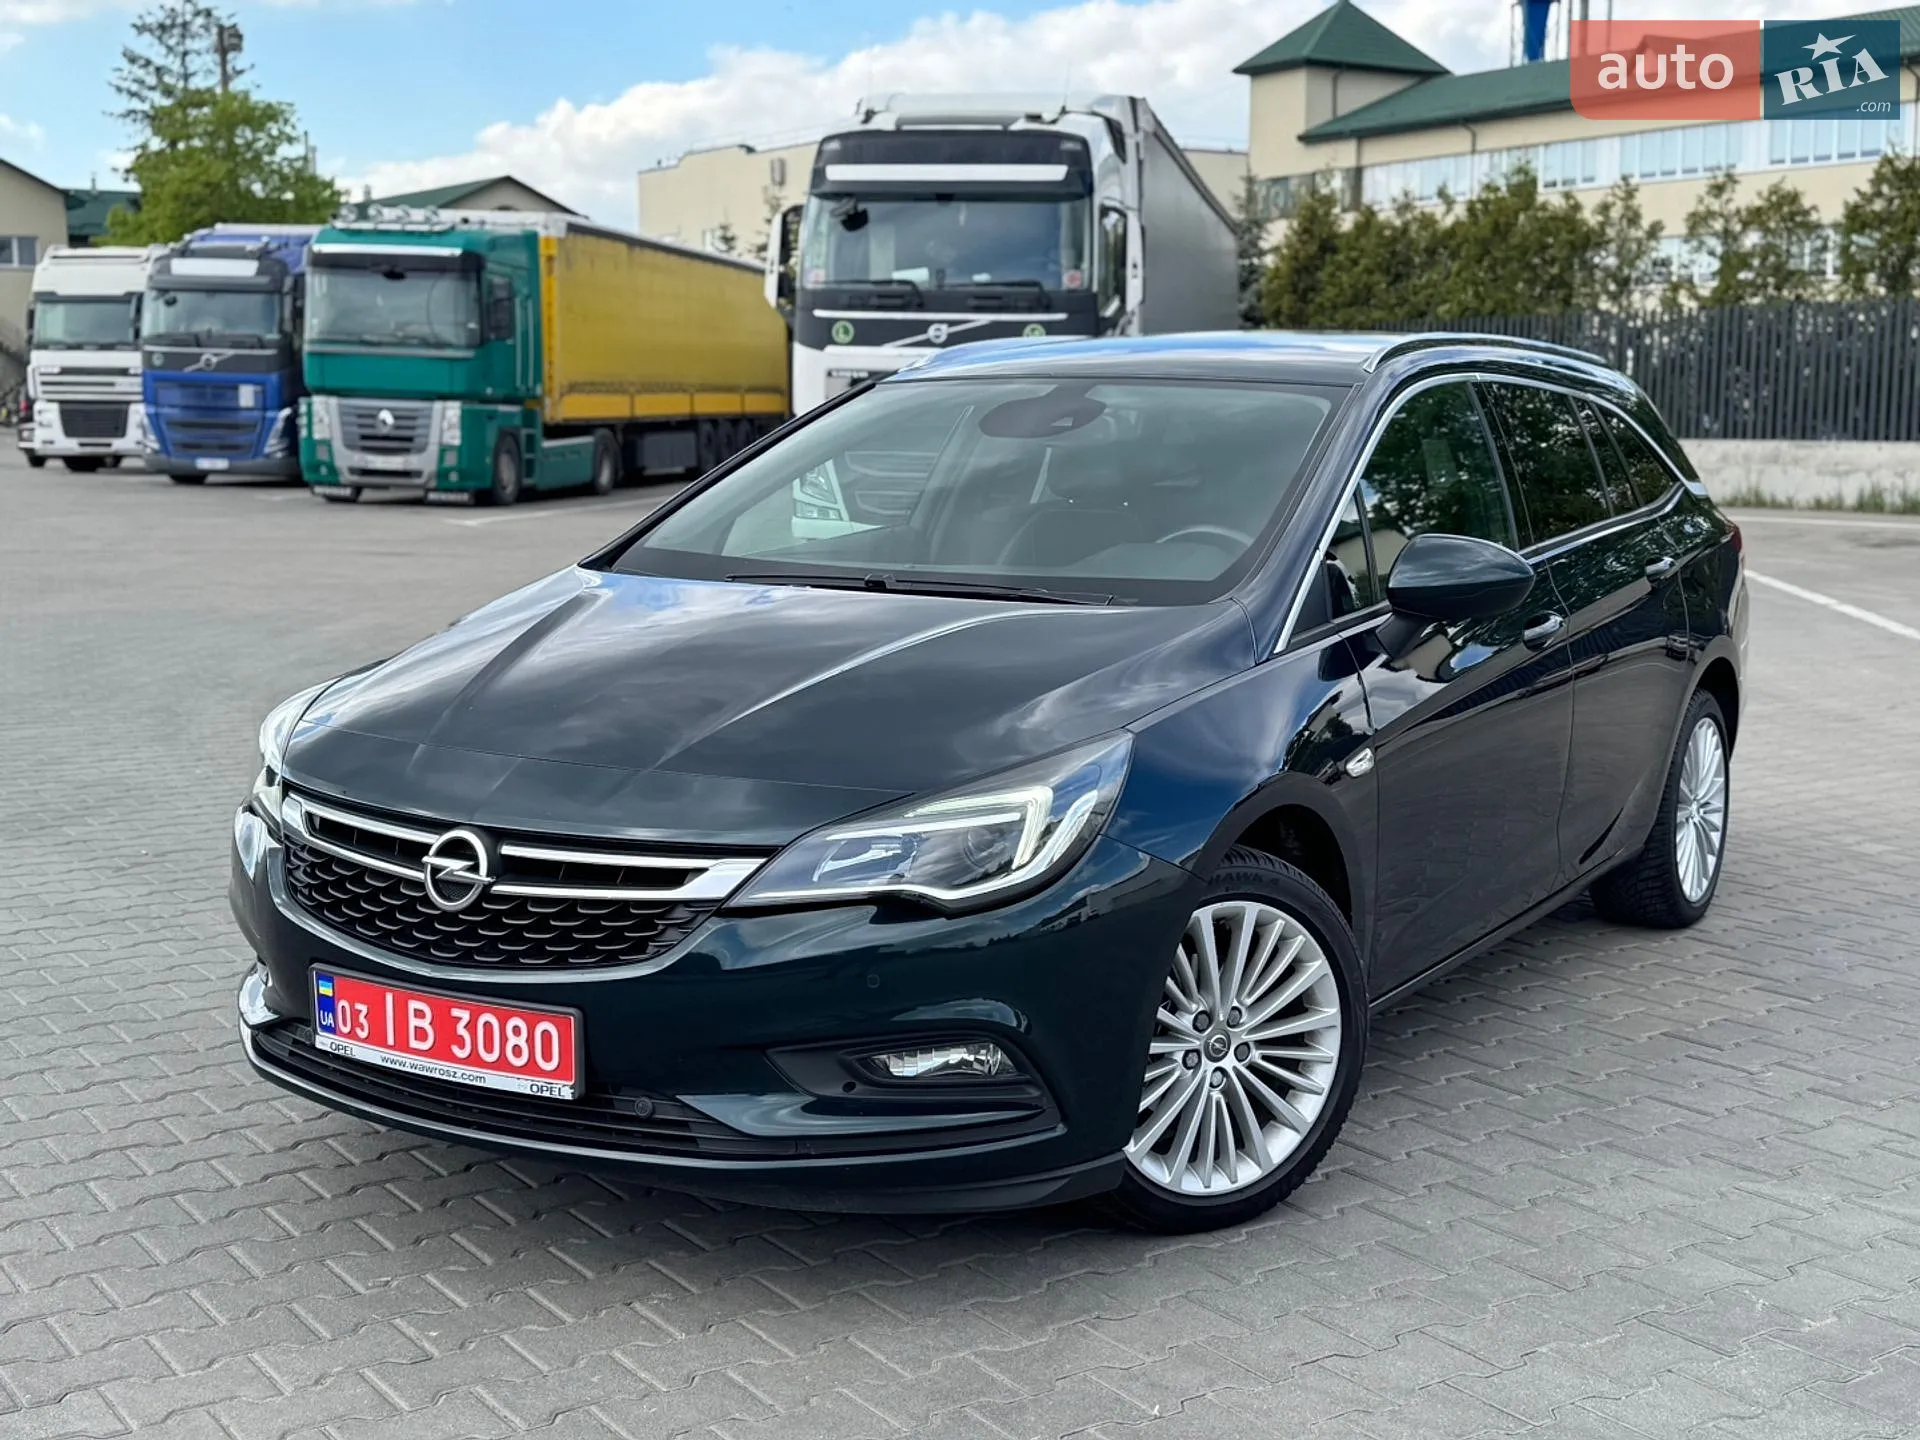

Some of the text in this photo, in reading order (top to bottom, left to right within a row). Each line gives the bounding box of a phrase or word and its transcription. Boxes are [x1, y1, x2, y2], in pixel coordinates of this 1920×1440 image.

[319, 1009, 335, 1028] UA
[337, 991, 560, 1072] 03 IB 3080
[330, 1041, 356, 1057] OPEL
[381, 1054, 487, 1084] www.wawrosz.com
[529, 1083, 565, 1098] OPEL
